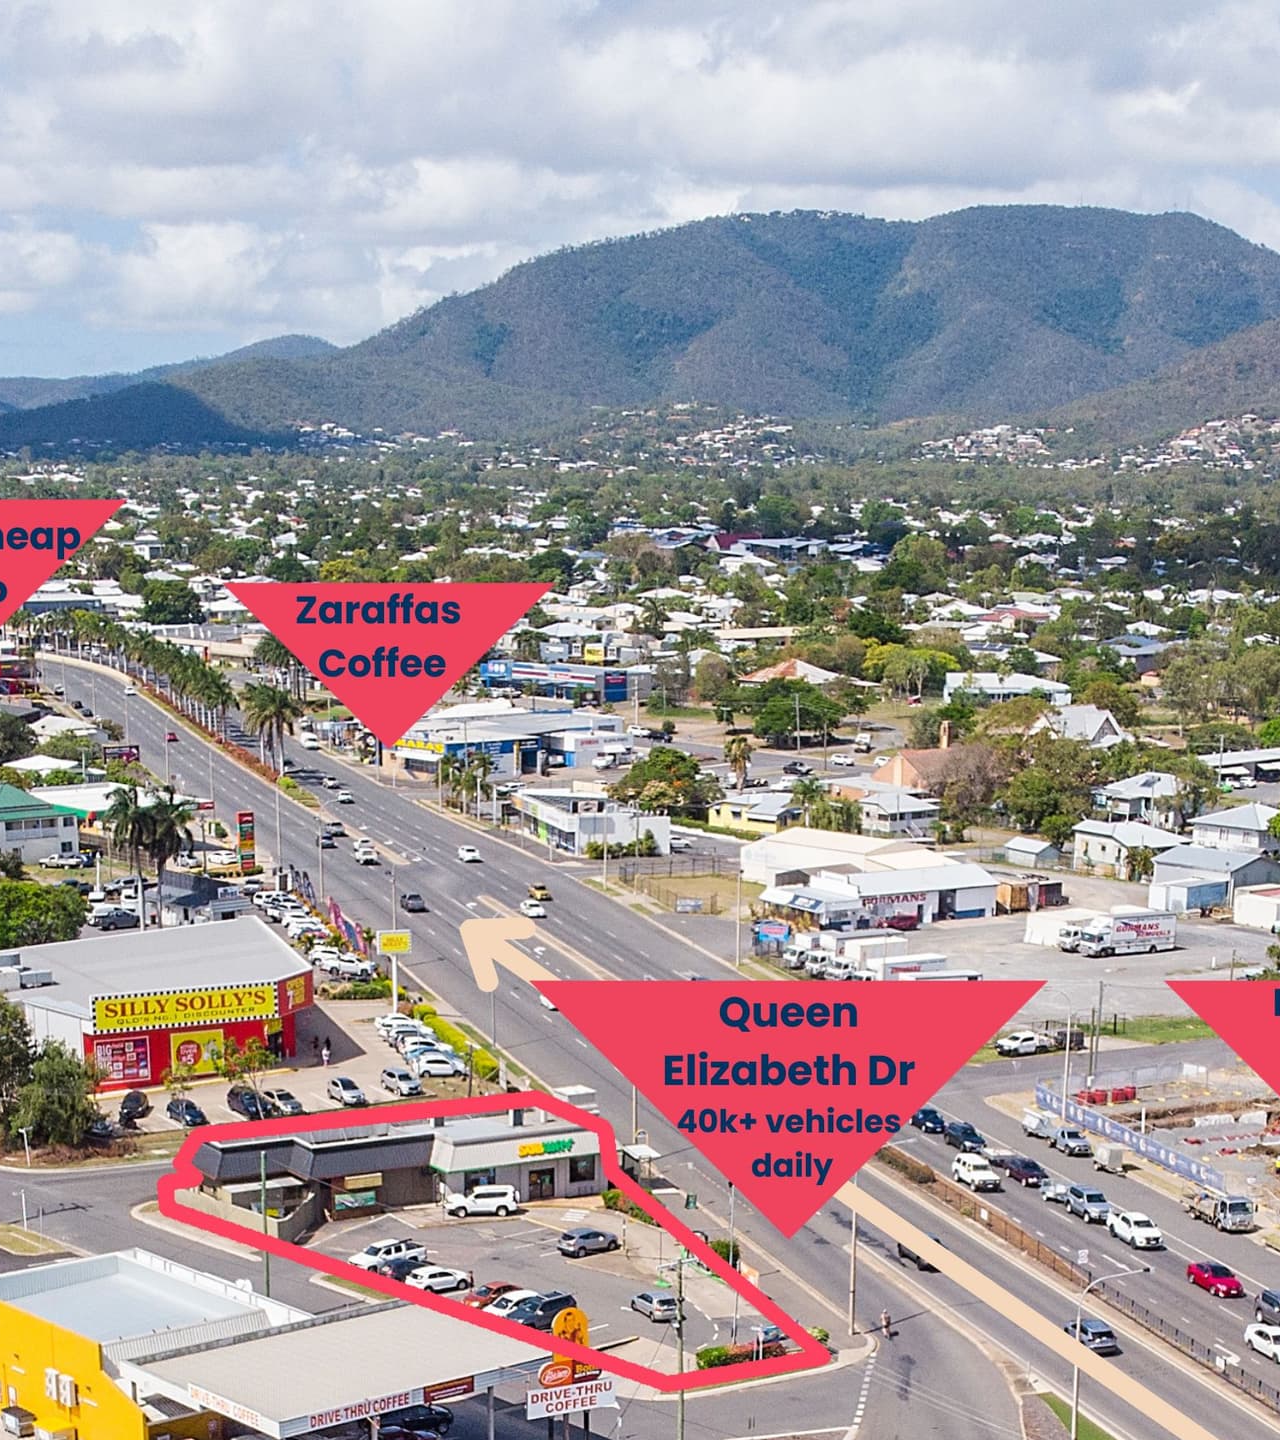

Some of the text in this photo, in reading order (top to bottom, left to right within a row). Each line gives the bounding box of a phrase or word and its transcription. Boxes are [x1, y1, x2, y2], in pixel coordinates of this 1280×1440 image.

[104, 990, 266, 1018] SILLY SOLLY'S
[184, 1007, 255, 1019] DISCOUNTER
[373, 1392, 409, 1412] COFFEE
[545, 1396, 597, 1413] COFFEE
